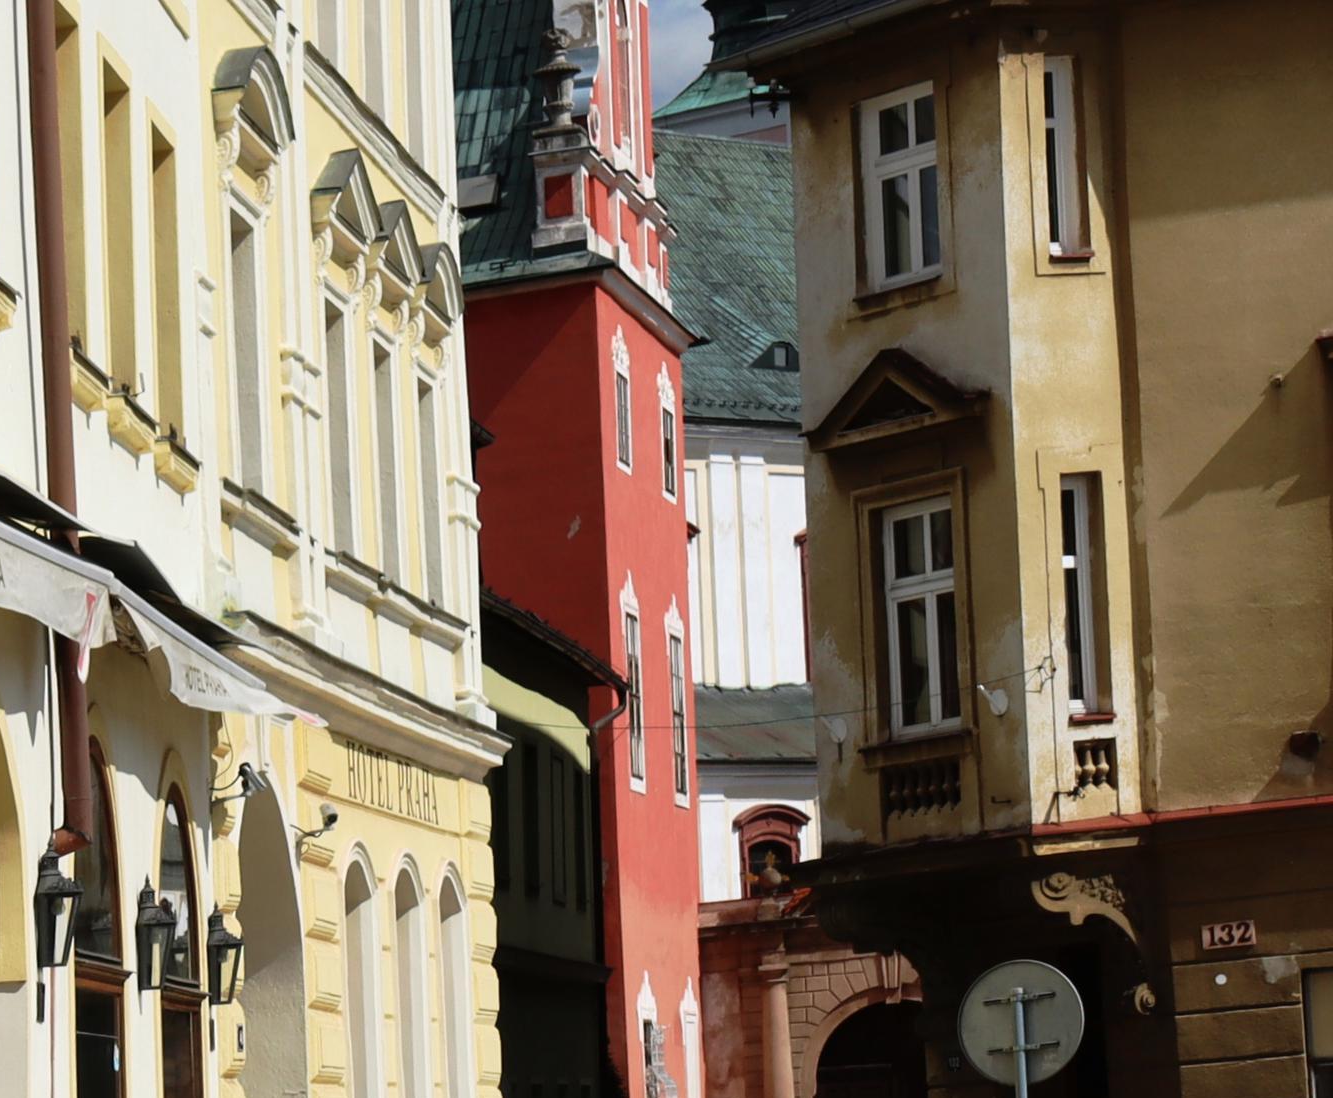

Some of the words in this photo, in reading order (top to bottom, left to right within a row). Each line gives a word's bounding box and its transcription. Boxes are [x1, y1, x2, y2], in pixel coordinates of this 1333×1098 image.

[346, 741, 394, 811] HOTEL
[397, 760, 439, 826] PRAHA
[1208, 922, 1252, 947] 132
